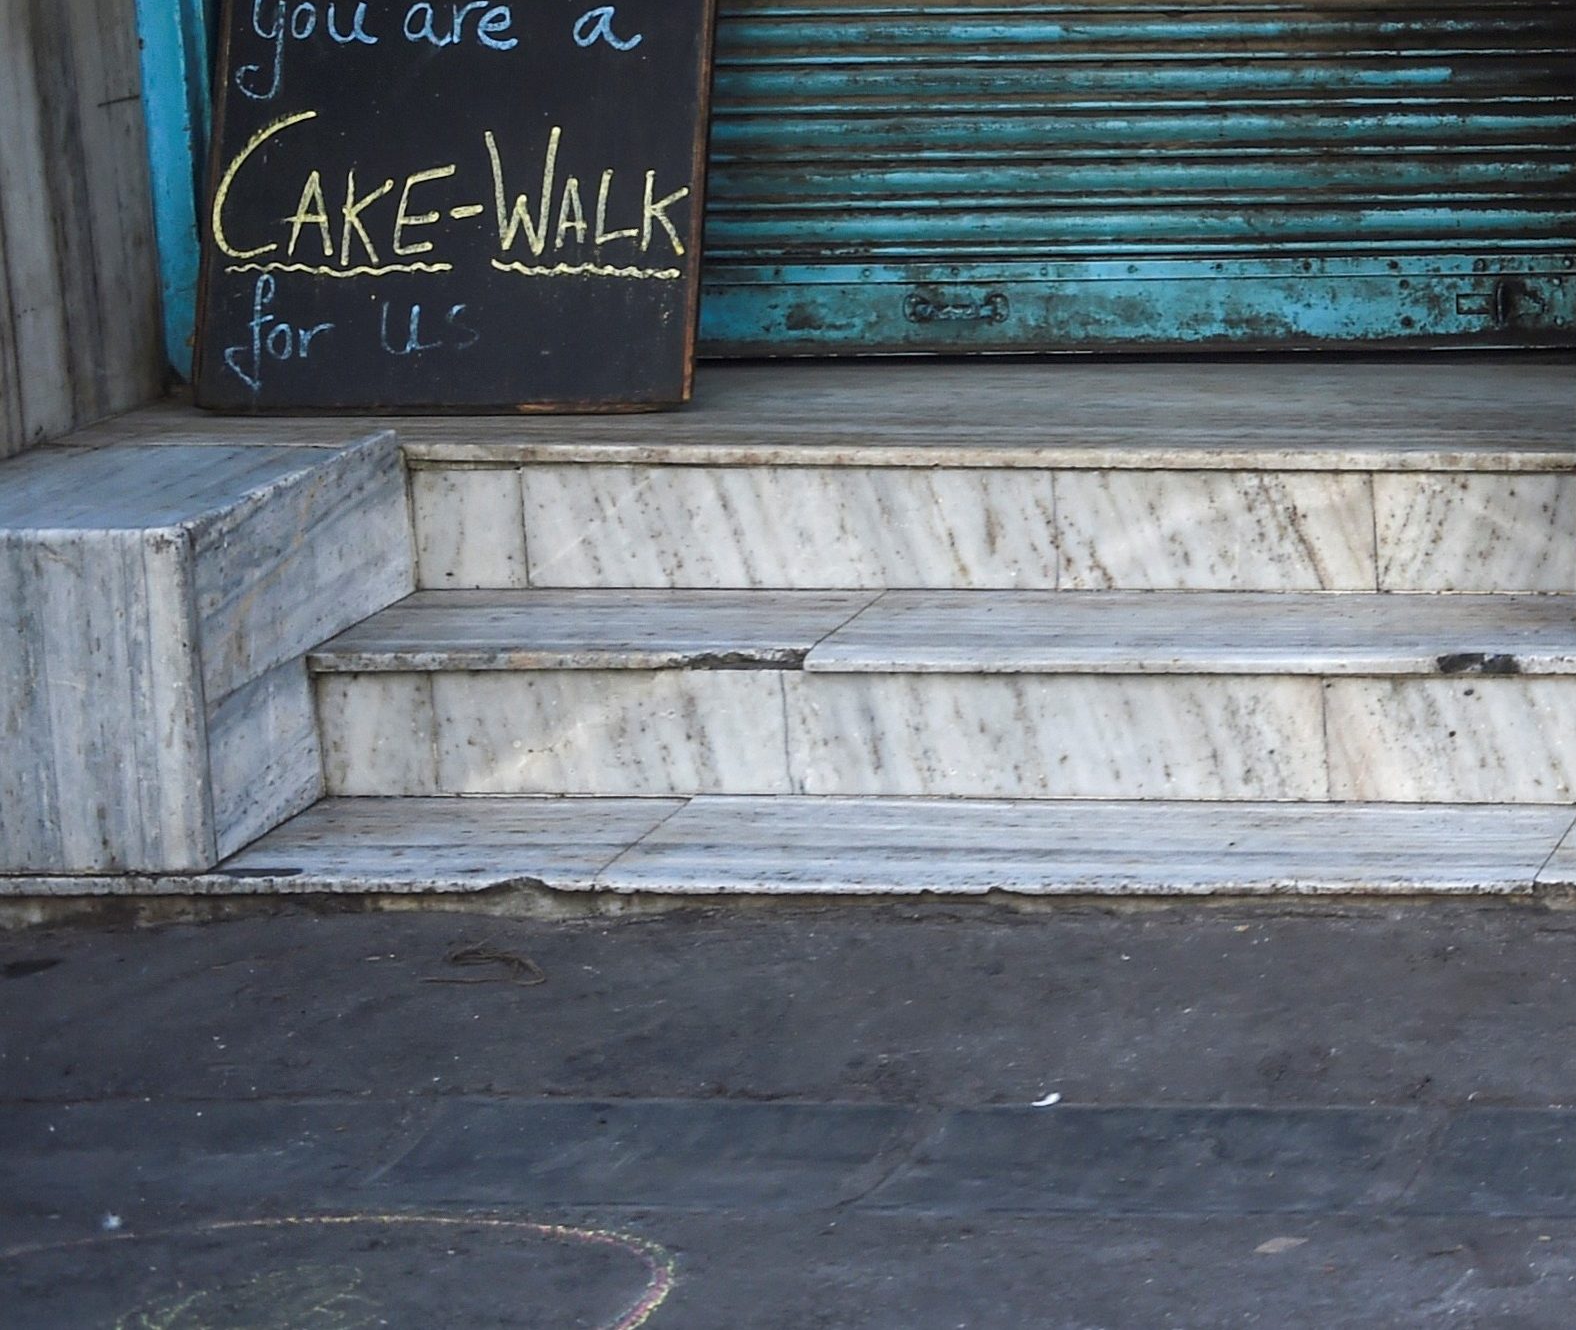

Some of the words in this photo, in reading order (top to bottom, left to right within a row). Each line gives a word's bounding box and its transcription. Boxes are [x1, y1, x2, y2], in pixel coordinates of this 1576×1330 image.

[403, 0, 520, 51] are
[572, 3, 642, 51] a
[212, 110, 690, 267] CAKE-WALK
[223, 274, 335, 392] for
[380, 300, 482, 356] us
